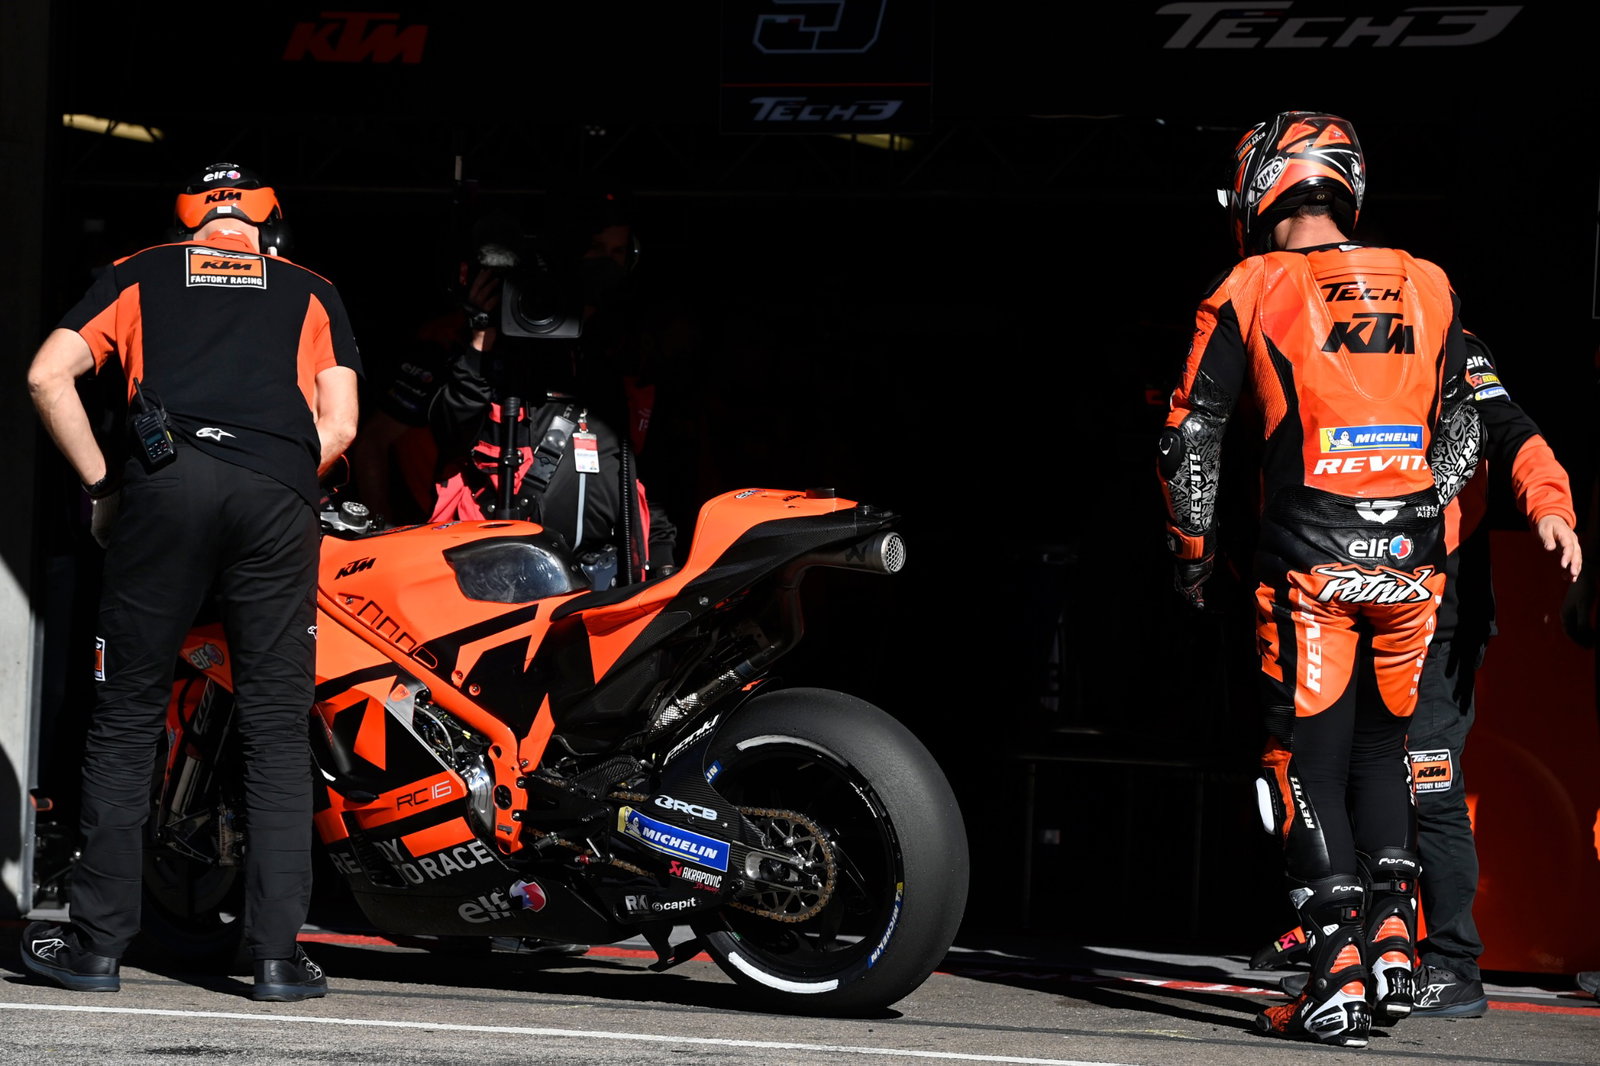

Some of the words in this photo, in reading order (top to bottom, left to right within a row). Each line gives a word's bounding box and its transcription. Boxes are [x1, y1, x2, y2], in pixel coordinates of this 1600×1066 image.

[1155, 1, 1524, 48] TECH3
[280, 10, 430, 63] KTM
[750, 97, 904, 121] TECH3
[203, 171, 227, 182] elf
[204, 189, 242, 204] KTM
[200, 260, 252, 271] KTM
[190, 275, 228, 284] FACTORY
[230, 277, 263, 286] RACING
[1321, 281, 1404, 302] TECH
[1321, 313, 1415, 354] KTM
[1355, 433, 1419, 444] MICHELIN
[1348, 538, 1389, 558] elf
[334, 557, 376, 580] KTM
[1417, 765, 1447, 778] KTM
[396, 780, 453, 812] RC16
[642, 827, 718, 861] MICHELIN
[418, 841, 494, 880] RACE
